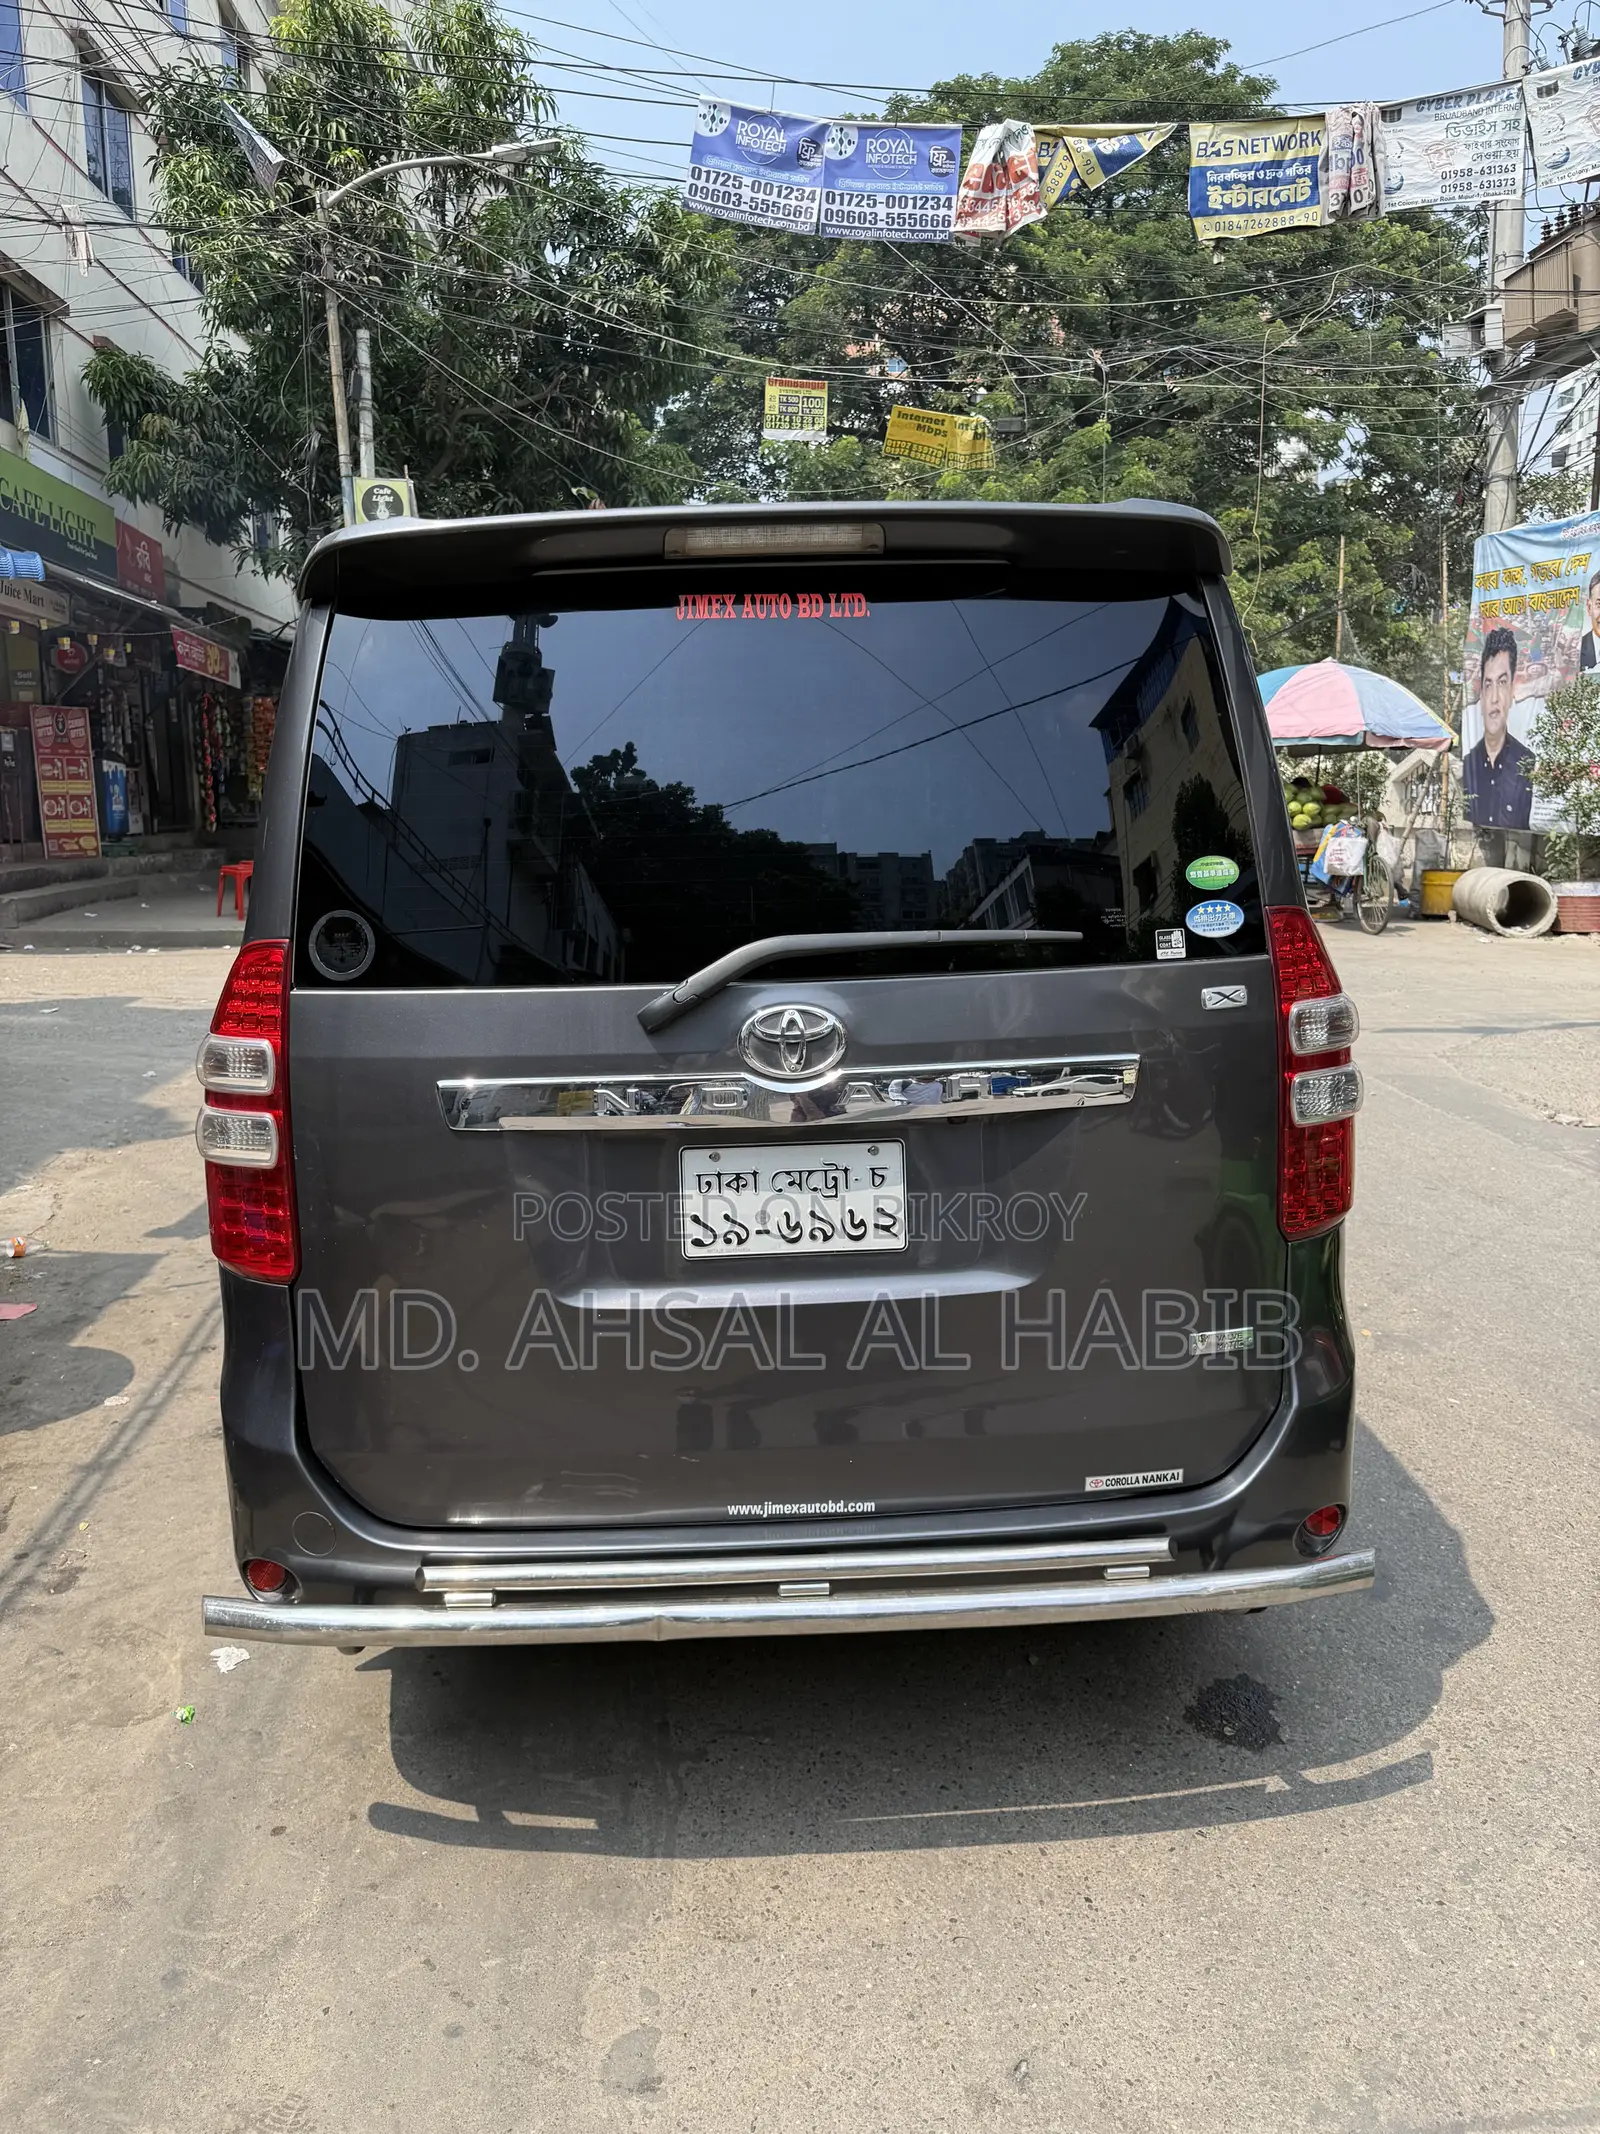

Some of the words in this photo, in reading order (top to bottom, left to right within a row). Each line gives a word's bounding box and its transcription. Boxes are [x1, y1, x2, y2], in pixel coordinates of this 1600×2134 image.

[1416, 95, 1464, 113] CYBER
[1434, 108, 1484, 121] BROADBAND
[1485, 102, 1522, 115] INTERNET
[737, 119, 787, 143] ROYAL
[1445, 120, 1498, 139] ডিভাইস
[1502, 118, 1523, 132] সহ
[736, 135, 786, 154] INFOTECH
[866, 138, 917, 154] ROYAL
[1238, 130, 1322, 155] NETWORK
[866, 154, 917, 165] INFOTECH
[1256, 171, 1265, 180] ও
[1266, 168, 1284, 181] দ্রুত
[1286, 163, 1312, 176] গতির
[1441, 163, 1516, 180] 01958-631363
[690, 166, 817, 203] 01725-001234
[1206, 177, 1313, 210] ইন্টারনেট
[1441, 177, 1516, 194] 01958-631373
[687, 183, 814, 220] 09603-555666
[825, 190, 953, 211] 01725-001234
[688, 200, 810, 232] www.royalinfotech.com.bd
[824, 208, 952, 229] 09603-555666
[1214, 211, 1318, 233] 01847262888-90
[825, 226, 949, 240] www.royalinfotech.com.bd
[803, 398, 821, 409] 100
[897, 411, 946, 426] Internet
[916, 423, 948, 438] Mbps
[372, 495, 394, 503] Light
[373, 487, 392, 495] Cafe
[0, 476, 46, 527] CAFE
[48, 501, 97, 550] LIGHT
[1565, 552, 1592, 576] দেশ
[0, 580, 21, 600] Juice
[23, 588, 45, 608] Mart
[1528, 585, 1581, 614] বাংলাদেশ
[676, 594, 737, 620] JIMEX
[741, 593, 792, 619] AUTO
[797, 593, 824, 618] BD
[829, 593, 871, 618] LTD.
[17, 671, 33, 679] Self
[695, 1167, 760, 1195] ঢাকা
[690, 1207, 900, 1248] ১৯-৬৯৬২
[1216, 1332, 1244, 1341] VALVE
[1105, 1475, 1140, 1488] COROLLA
[1142, 1471, 1180, 1484] NANKAI
[727, 1499, 876, 1518] www.jimexautobd.com
